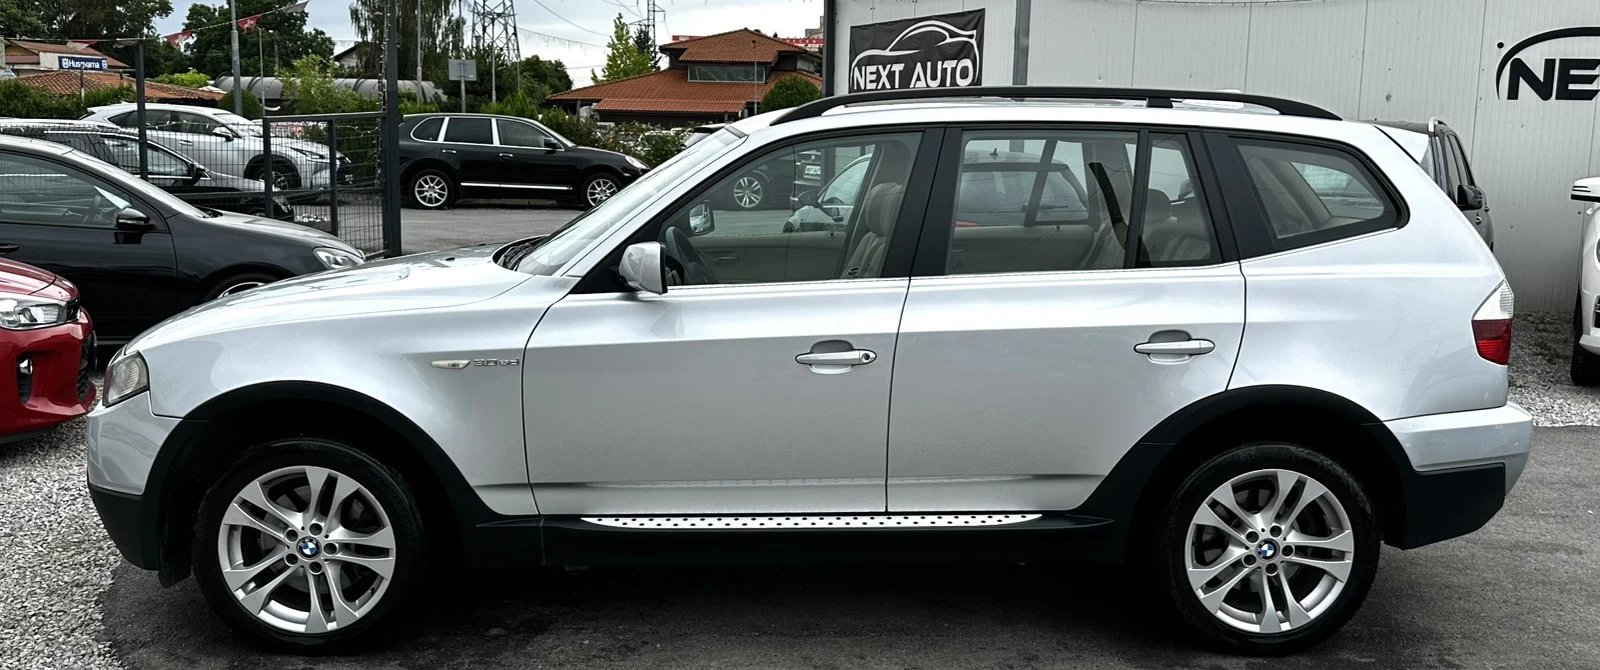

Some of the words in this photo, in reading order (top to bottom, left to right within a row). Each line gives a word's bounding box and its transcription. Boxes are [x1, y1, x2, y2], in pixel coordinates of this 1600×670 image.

[69, 59, 100, 69] Husqvarna
[853, 63, 905, 91] NEXT
[909, 58, 974, 88] AUTO
[1506, 57, 1600, 101] NE
